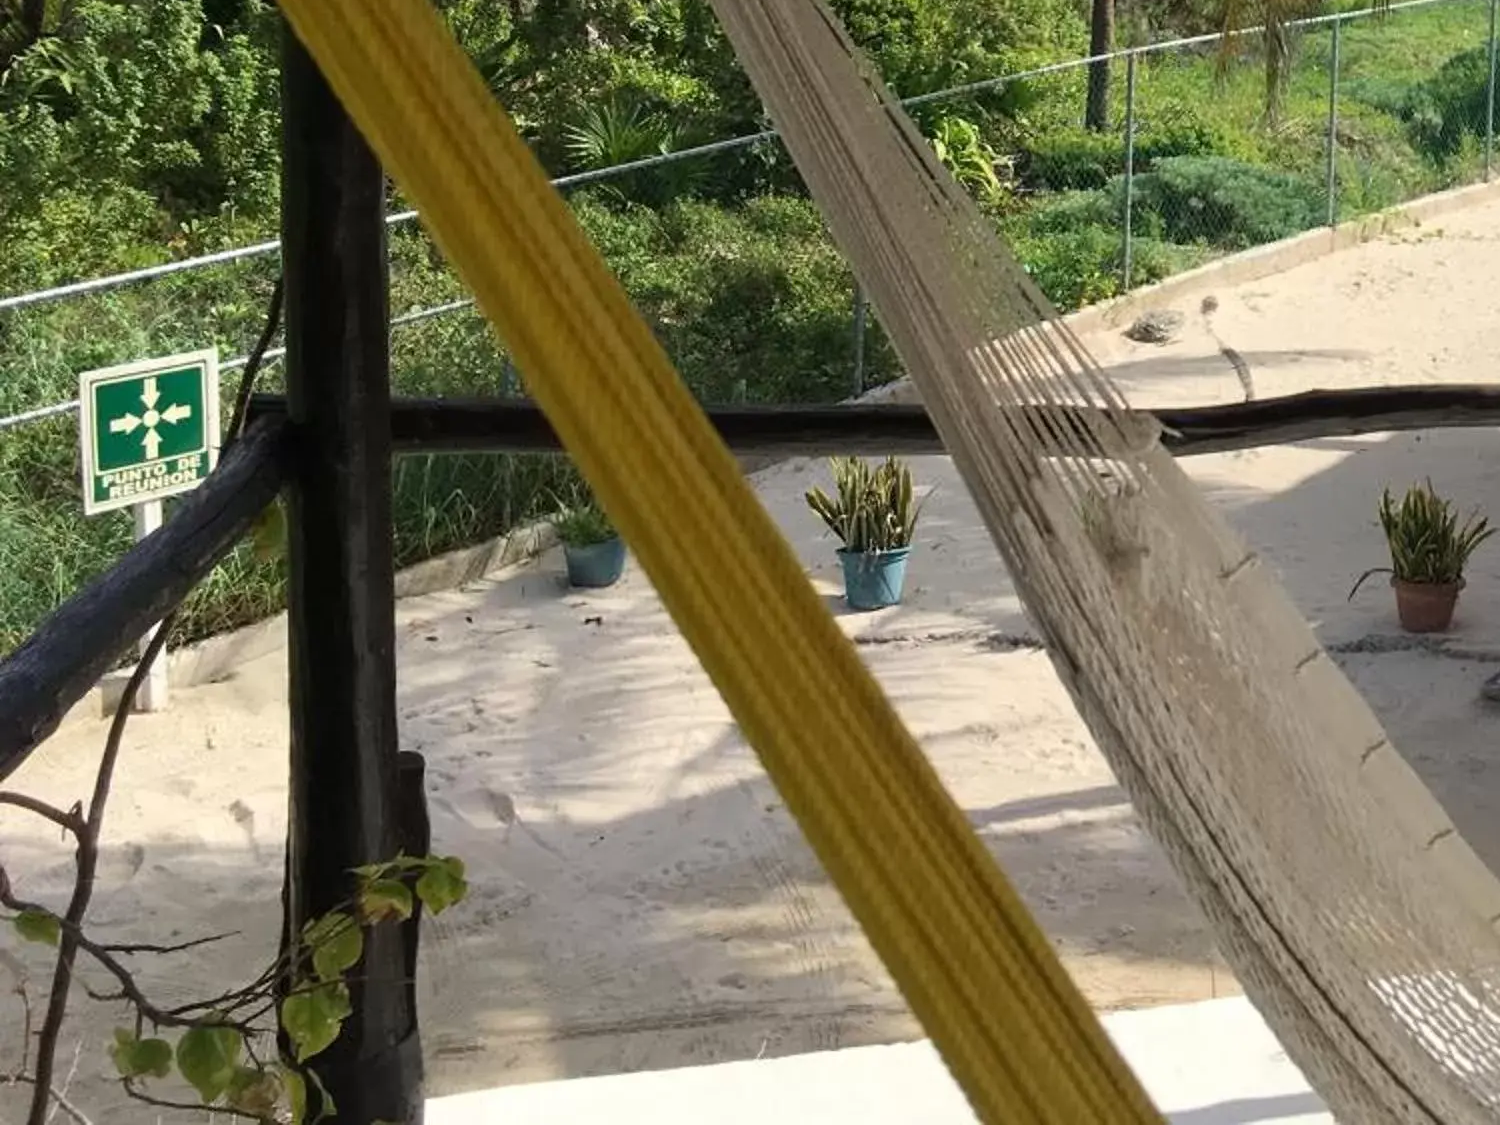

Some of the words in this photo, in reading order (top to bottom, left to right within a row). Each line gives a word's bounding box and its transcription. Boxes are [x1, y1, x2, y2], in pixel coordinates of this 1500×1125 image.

[102, 463, 167, 488] PUNTO
[177, 454, 201, 470] DE
[109, 469, 197, 498] REUNION
